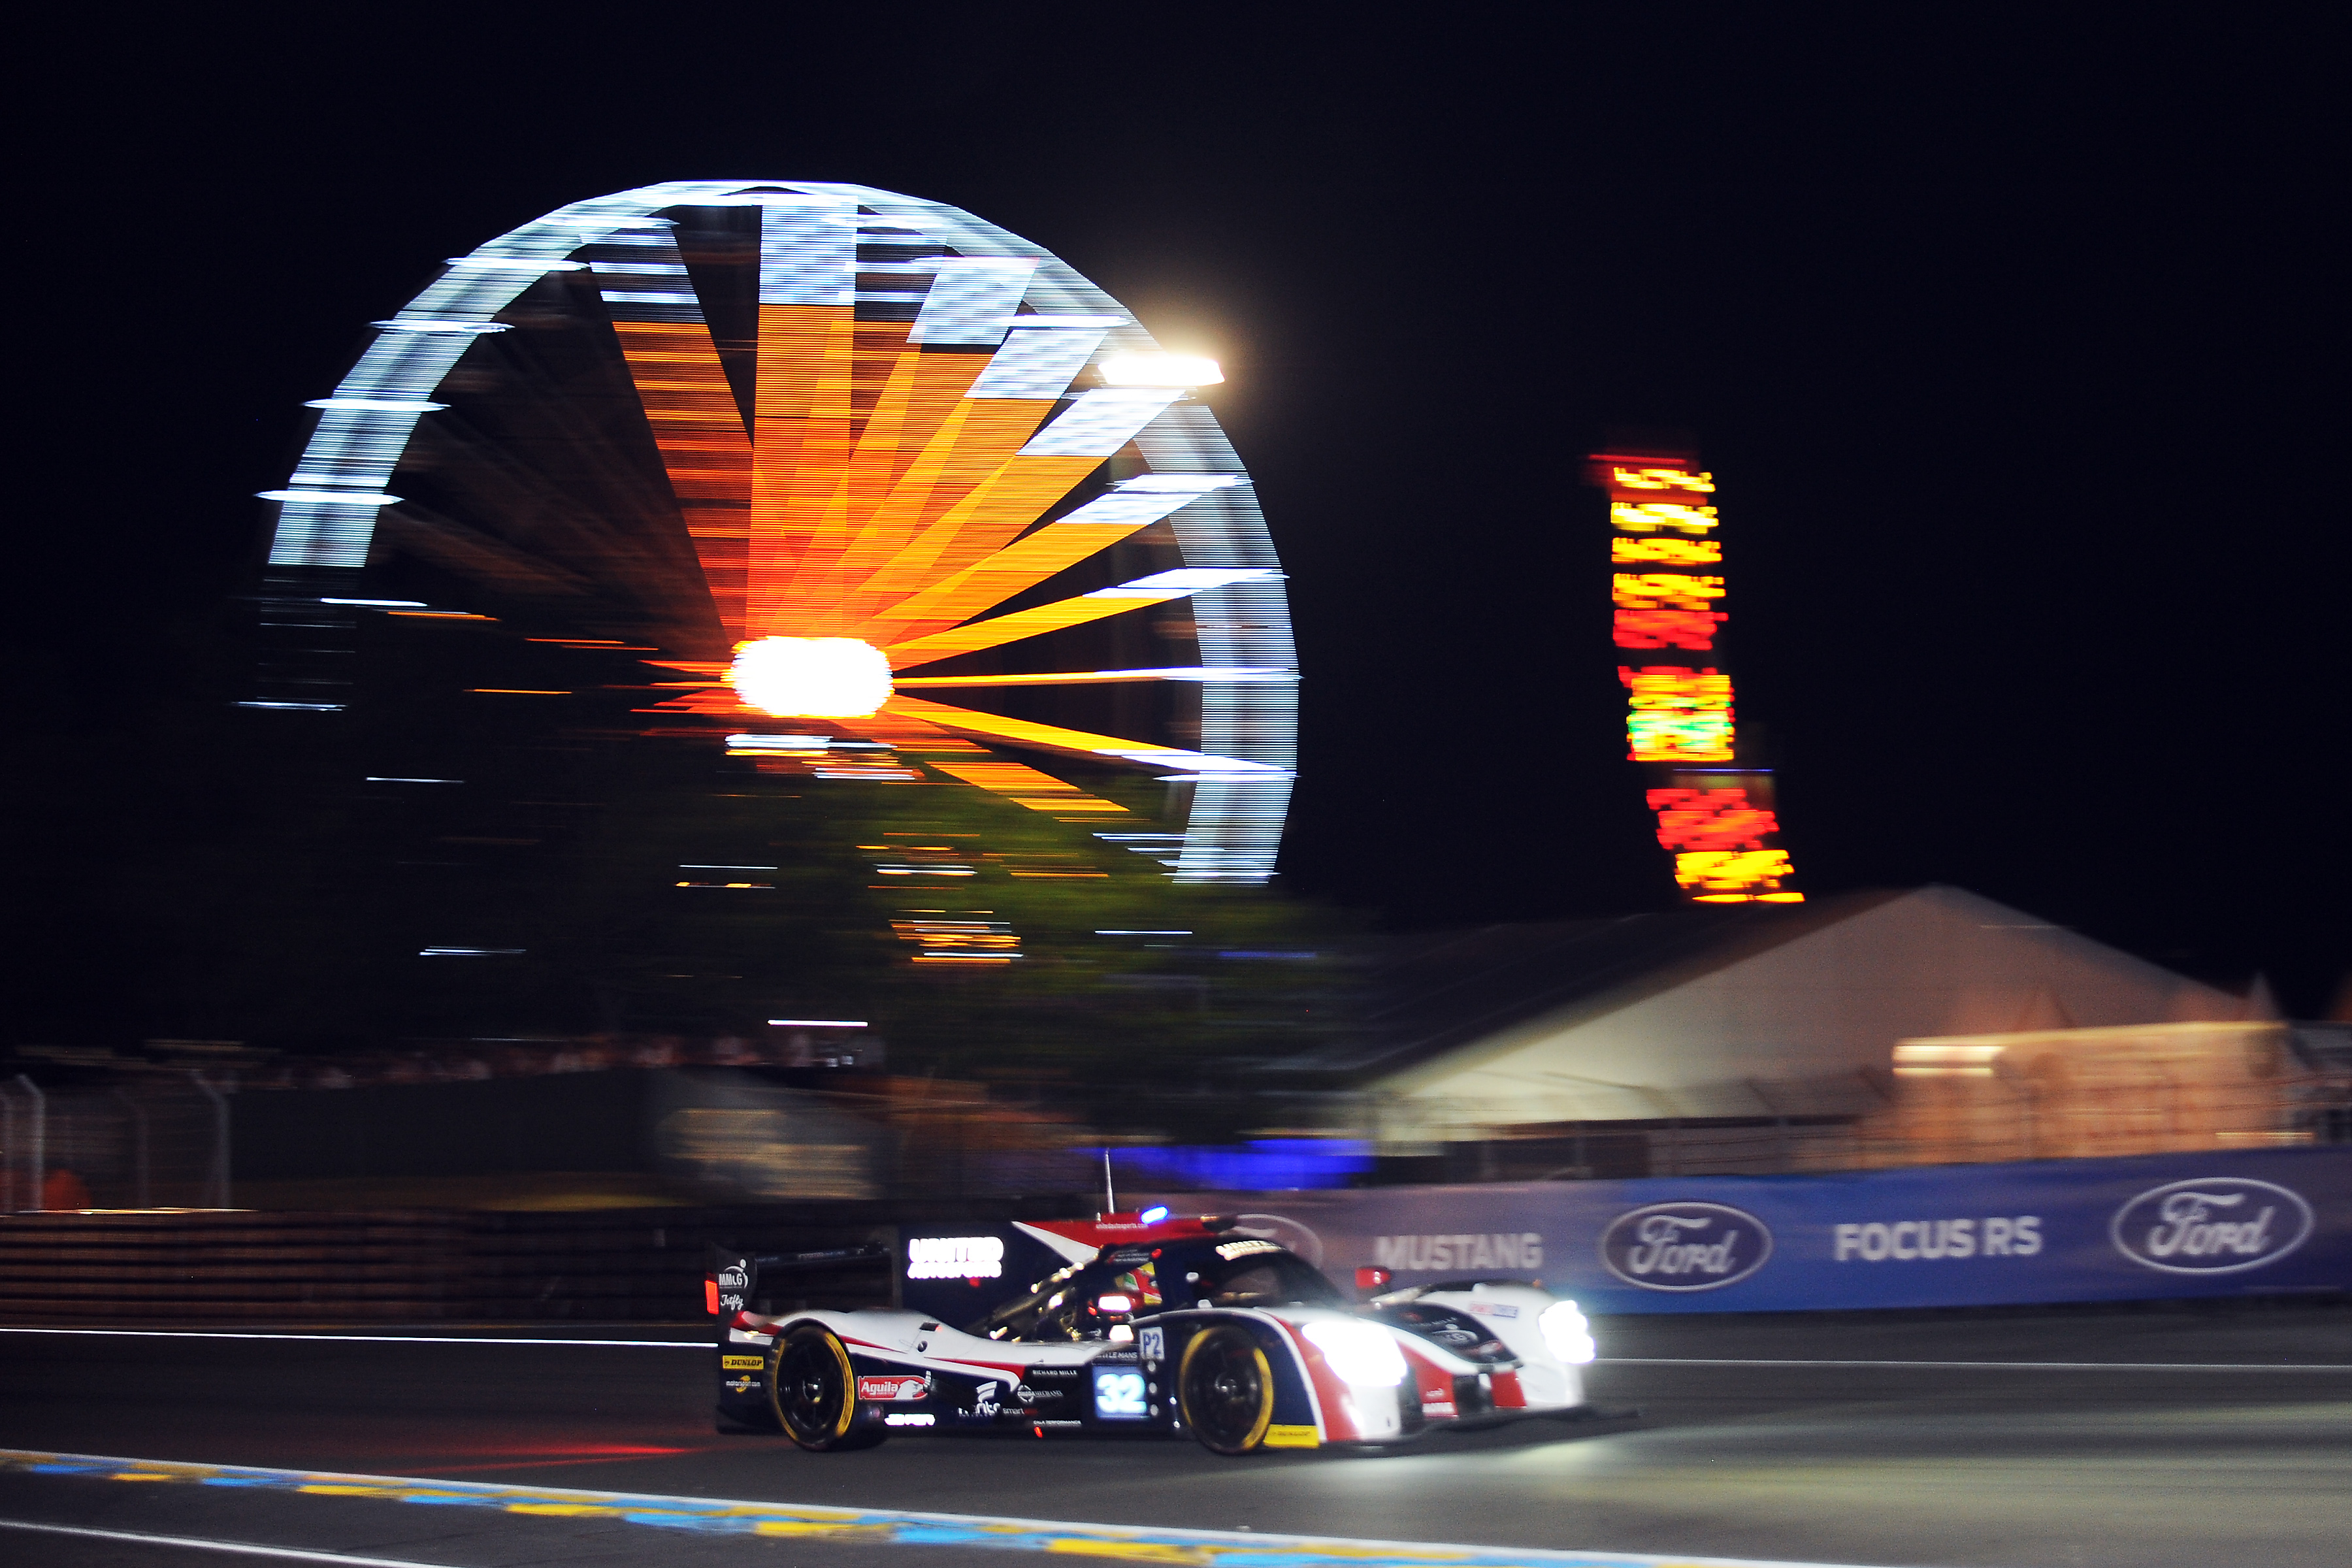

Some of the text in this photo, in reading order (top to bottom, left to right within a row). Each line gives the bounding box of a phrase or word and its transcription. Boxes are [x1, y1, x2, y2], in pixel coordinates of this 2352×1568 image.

[1834, 1215, 2042, 1261] FOCUS RS
[2149, 1192, 2275, 1256] Ford
[1375, 1232, 1543, 1269] MUSTANG
[1629, 1215, 1739, 1274] Ford
[1143, 1333, 1161, 1359] P2
[861, 1380, 899, 1396] Aguila
[1097, 1373, 1147, 1413] 32
